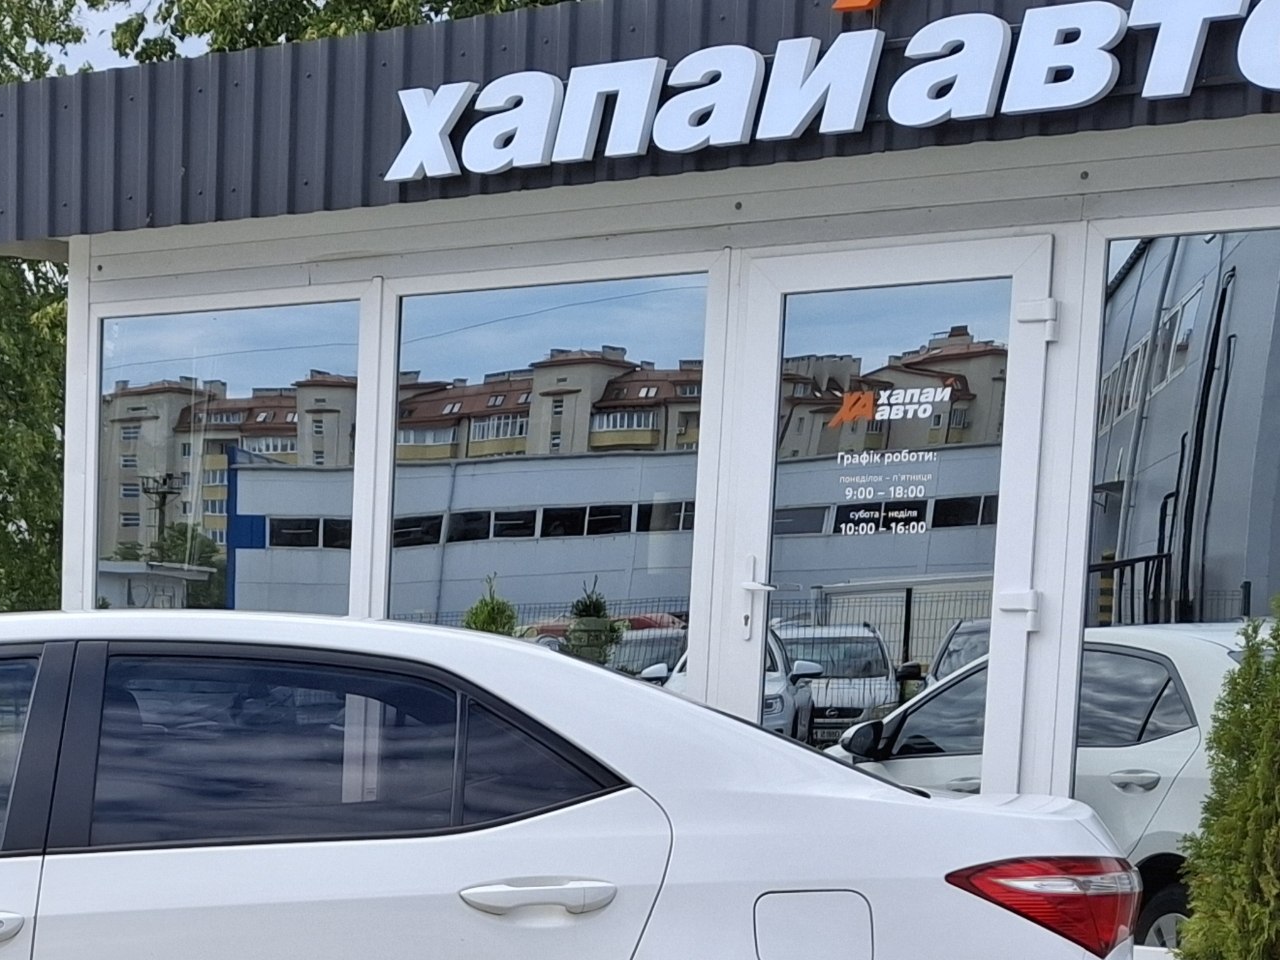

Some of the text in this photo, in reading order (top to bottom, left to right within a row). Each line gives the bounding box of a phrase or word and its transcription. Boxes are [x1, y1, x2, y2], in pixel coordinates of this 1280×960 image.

[874, 403, 933, 421] авто
[837, 449, 937, 467] Графік роботи:
[844, 486, 874, 500] 9:00
[889, 485, 925, 498] 18:00
[849, 509, 880, 520] субота
[888, 509, 918, 519] неділя
[840, 522, 875, 535] 10:00
[890, 521, 926, 535] 16:00
